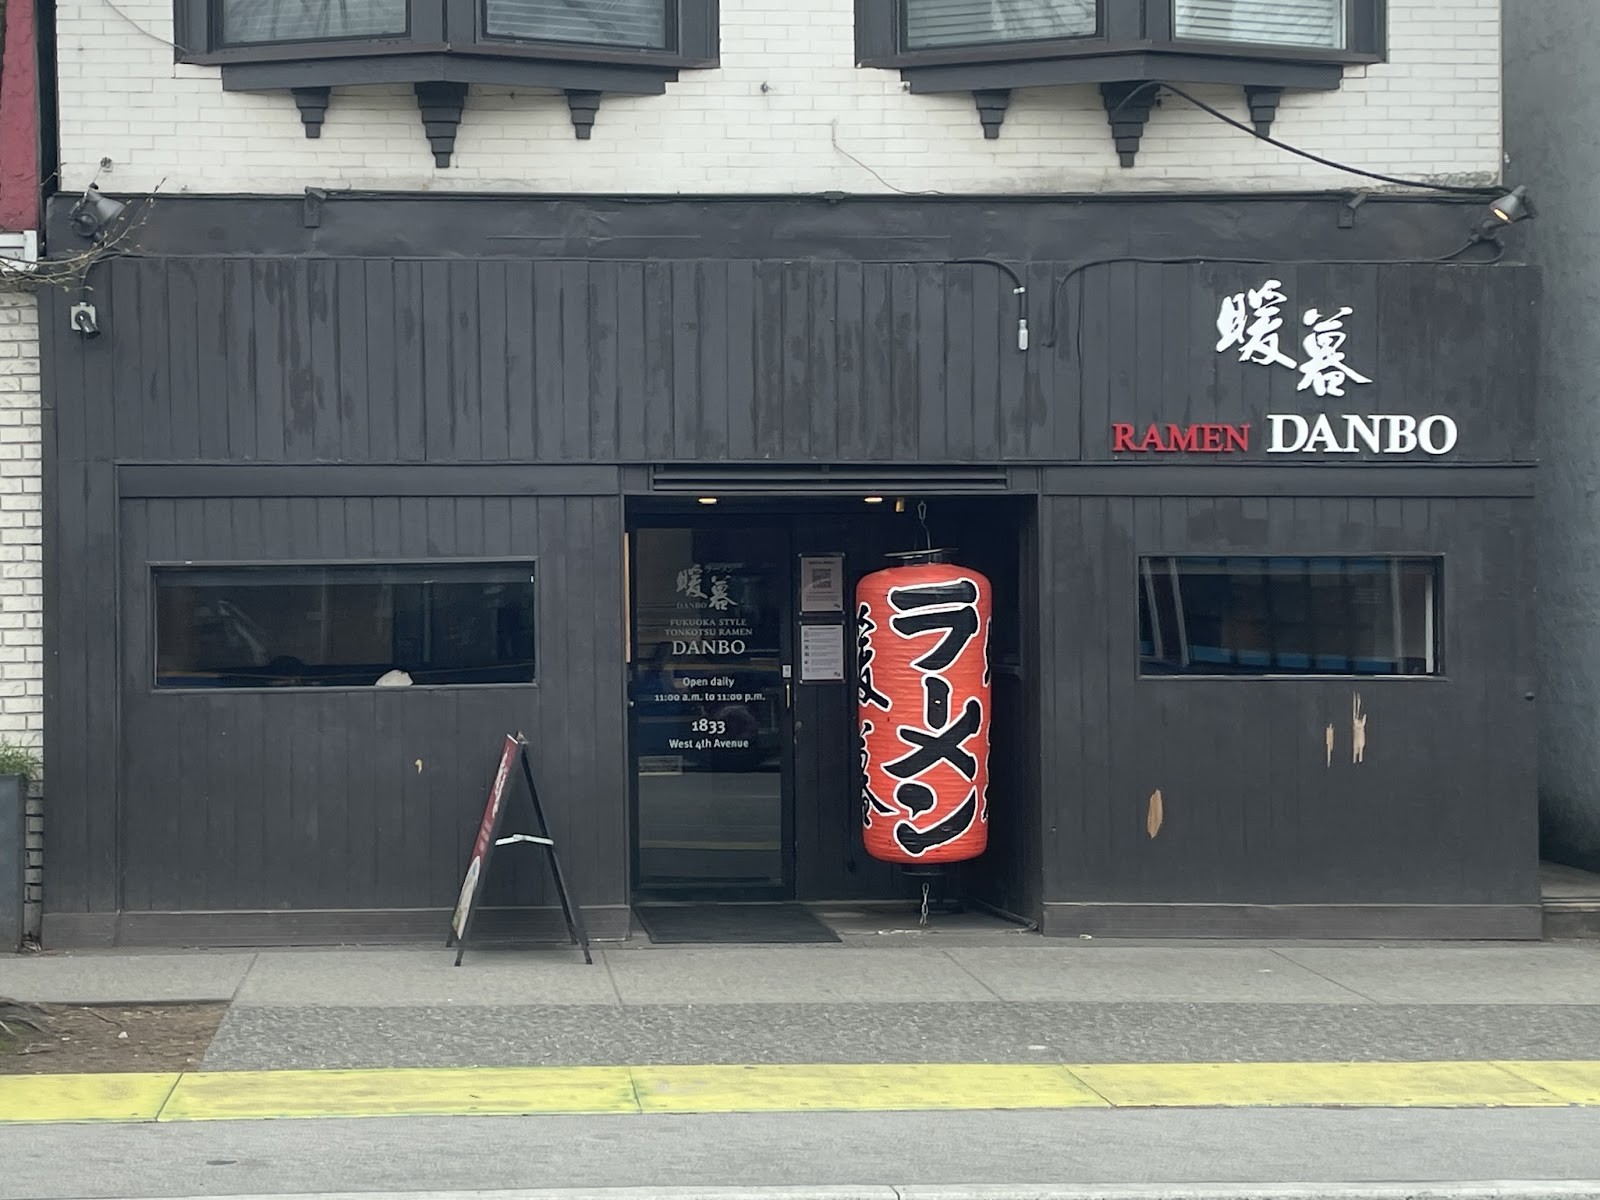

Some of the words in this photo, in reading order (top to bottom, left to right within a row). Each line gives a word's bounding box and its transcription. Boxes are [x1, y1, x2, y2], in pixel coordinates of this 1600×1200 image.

[1112, 423, 1250, 452] RAMEN
[1266, 413, 1458, 455] DANBO
[670, 618, 716, 627] FUKUOKA
[718, 618, 748, 626] STYLE
[665, 628, 716, 636] TONKOTSU
[718, 628, 753, 636] RAMEN
[671, 639, 746, 655] DANBO
[682, 677, 708, 688] Open
[710, 676, 735, 688] daily
[655, 693, 681, 702] 11:00
[682, 693, 703, 701] a.m.
[705, 692, 715, 701] to
[717, 693, 743, 701] 11:00
[744, 692, 766, 703] p.m.
[881, 577, 983, 858] ラーメン
[692, 718, 726, 734] 1833
[669, 739, 693, 749] West
[695, 738, 712, 751] 4th
[713, 738, 749, 749] Avenue
